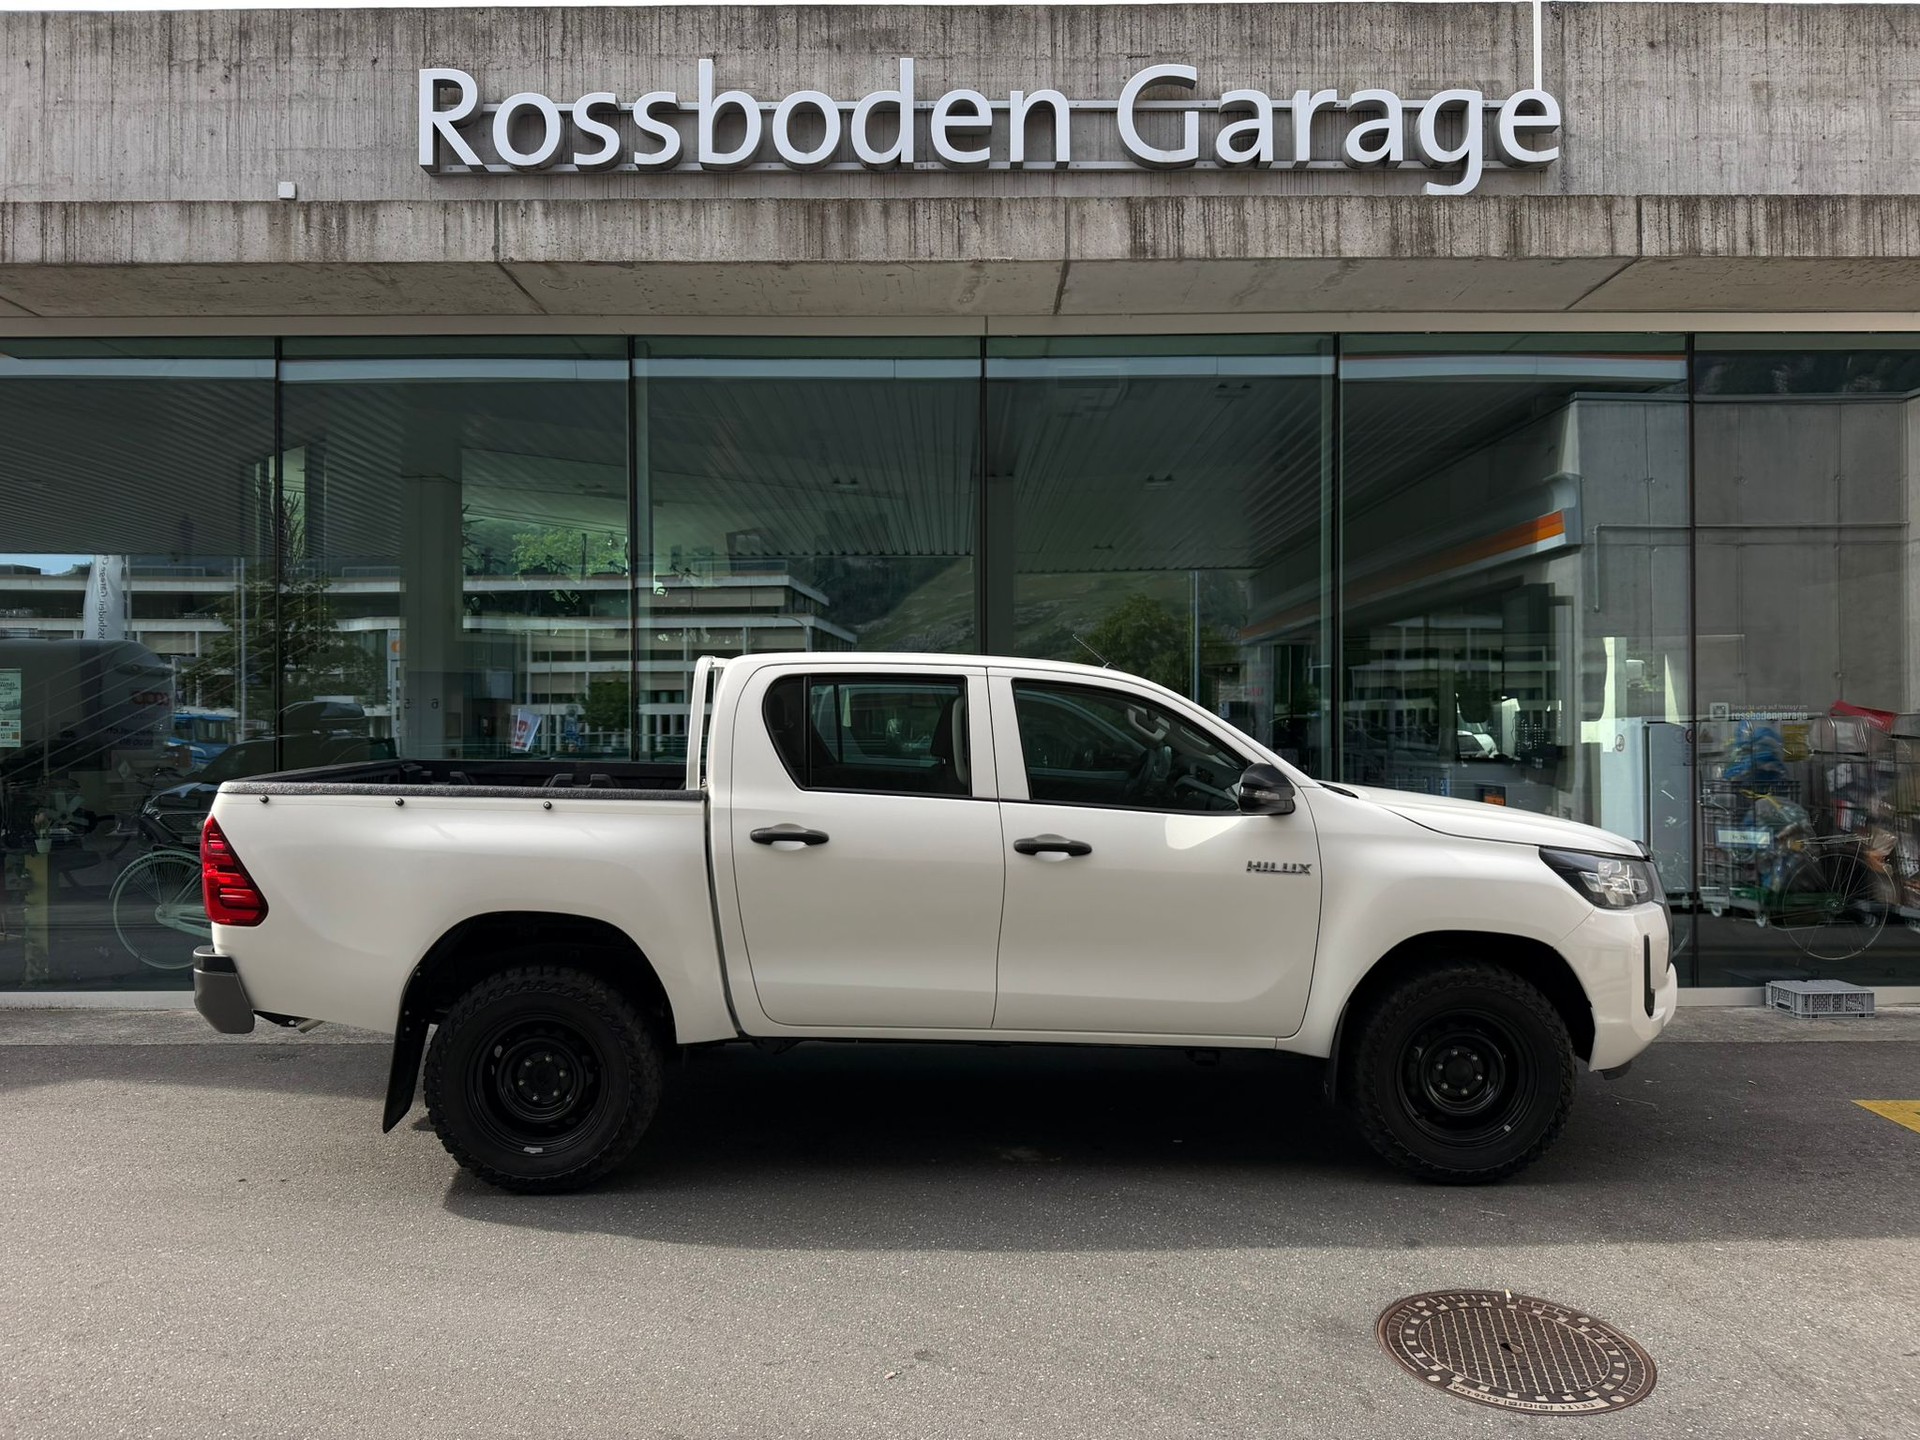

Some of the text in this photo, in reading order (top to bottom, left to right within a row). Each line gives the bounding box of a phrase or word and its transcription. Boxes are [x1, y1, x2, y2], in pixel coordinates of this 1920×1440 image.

[419, 58, 1560, 195] Rossboden Garage
[1731, 711, 1808, 721] rossbodengarage
[1246, 860, 1312, 875] HILUX
